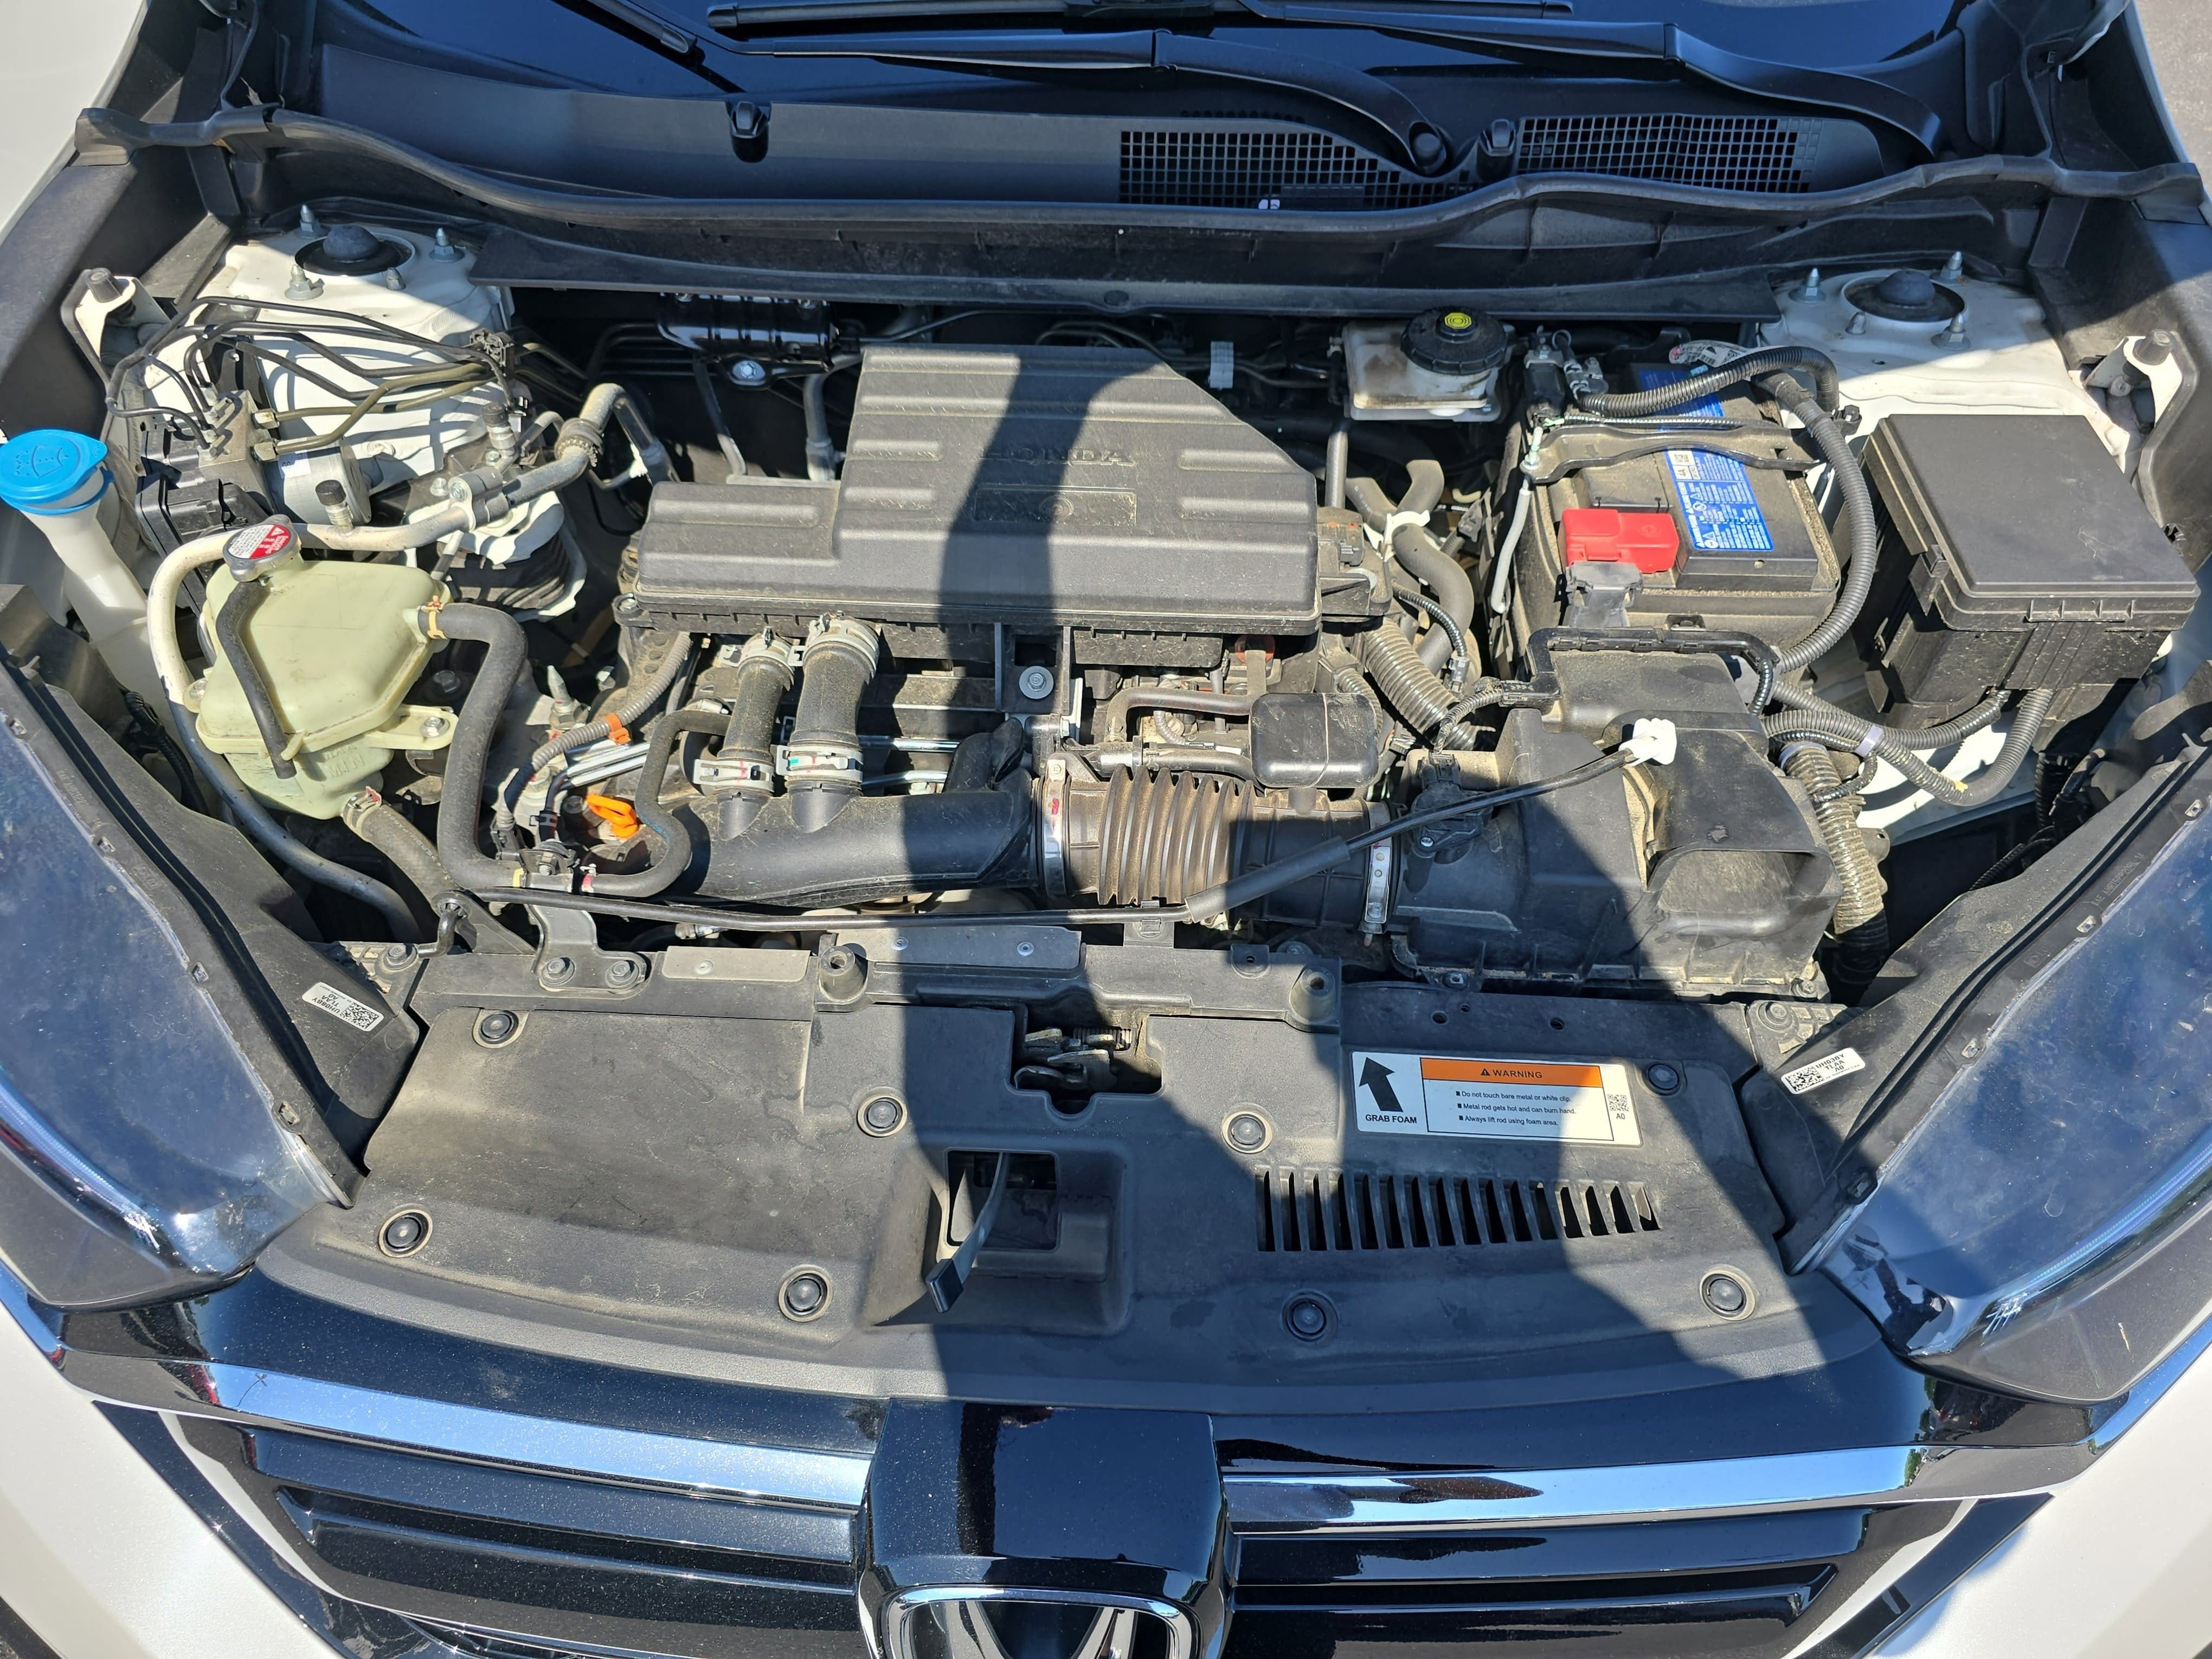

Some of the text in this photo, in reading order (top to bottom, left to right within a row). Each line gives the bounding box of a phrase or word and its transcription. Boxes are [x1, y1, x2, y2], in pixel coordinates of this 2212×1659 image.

[980, 448, 1136, 465] HONDA
[328, 754, 365, 778] MIN
[321, 995, 339, 1007] TLAA
[1824, 1060, 1846, 1071] TLAA
[1492, 1069, 1543, 1078] WARNING
[1365, 1114, 1417, 1124] GRAB FOAM
